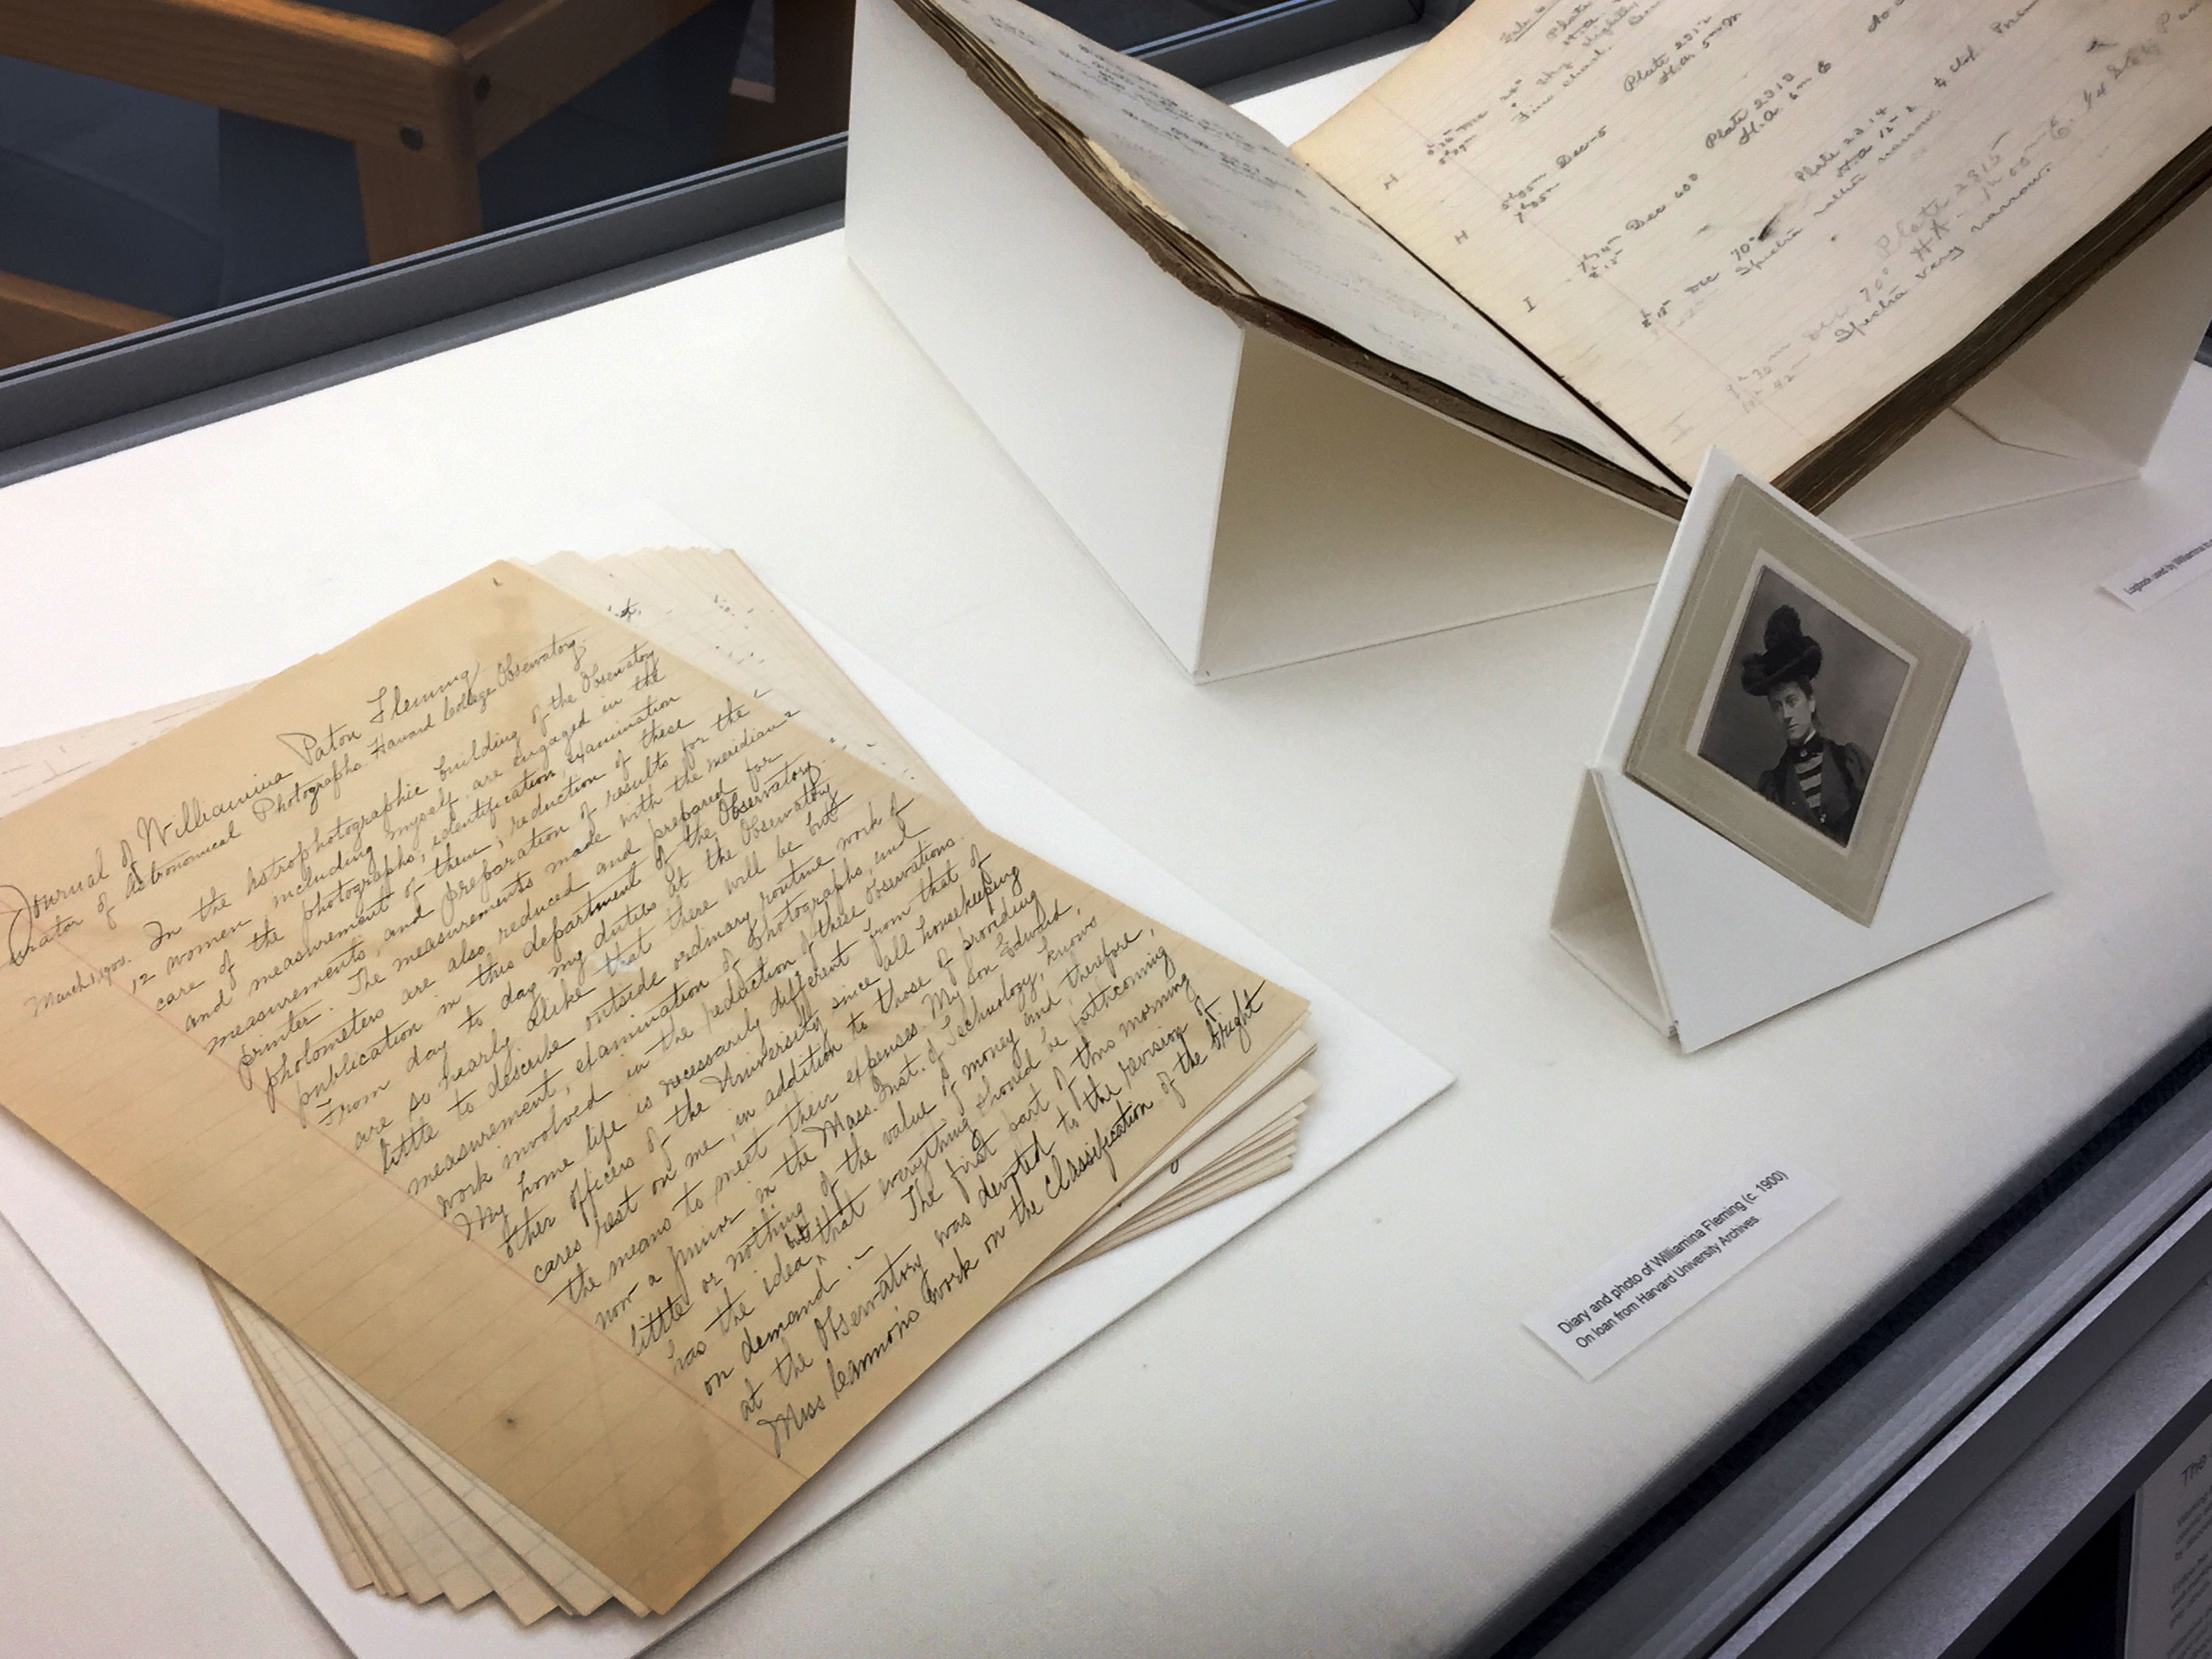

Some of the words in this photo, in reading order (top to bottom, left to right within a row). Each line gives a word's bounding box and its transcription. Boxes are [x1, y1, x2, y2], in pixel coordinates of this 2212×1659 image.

[1557, 1309, 1593, 1335] Diary
[1589, 1293, 1613, 1313] and
[1612, 1273, 1643, 1300] photo
[1641, 1263, 1656, 1276] of
[1651, 1227, 1707, 1268] Williamina
[1701, 1199, 1748, 1233] Fleming
[1755, 1170, 1788, 1193] 1900)
[1576, 1335, 1594, 1349] On
[1593, 1317, 1618, 1338] loan
[1616, 1300, 1640, 1322] from
[1639, 1272, 1678, 1305] Harvard
[1675, 1245, 1722, 1279] University
[2182, 1454, 2207, 1486] The
